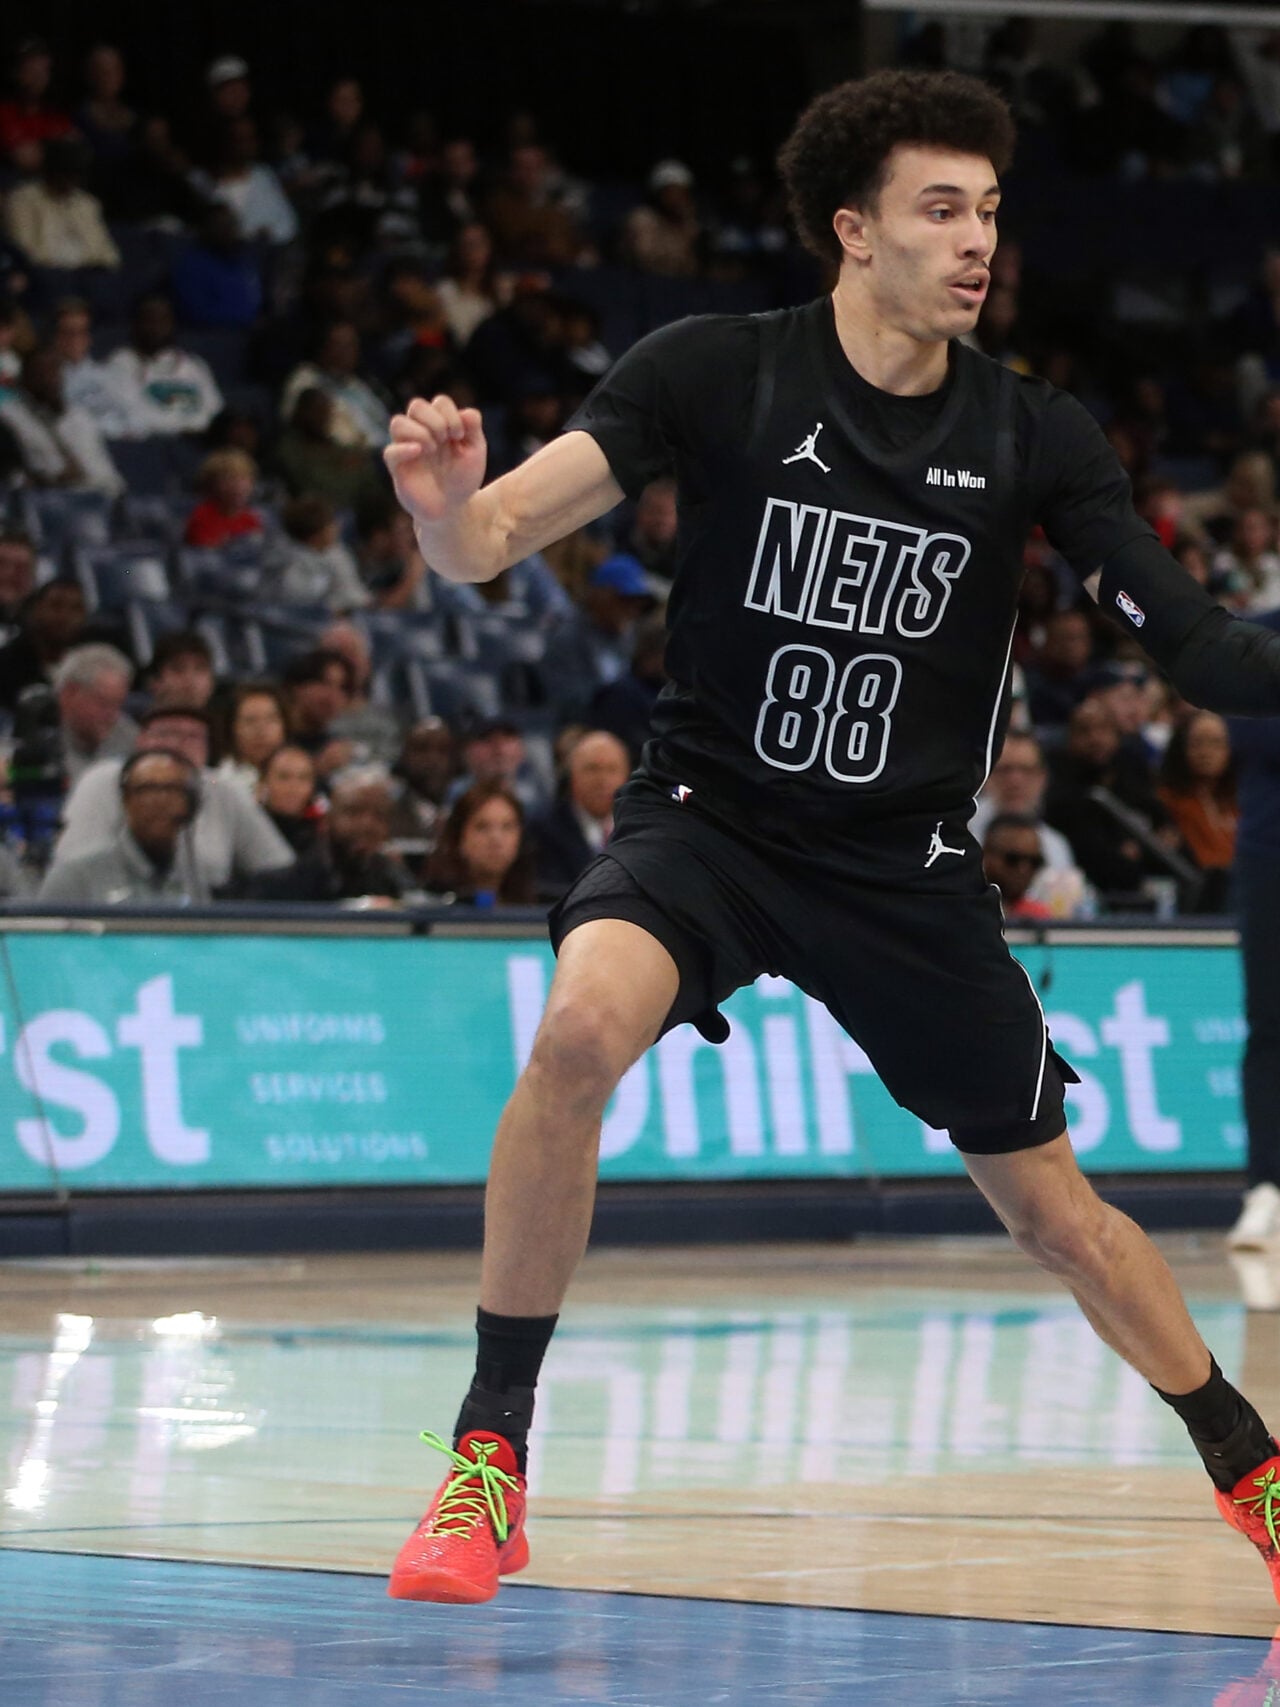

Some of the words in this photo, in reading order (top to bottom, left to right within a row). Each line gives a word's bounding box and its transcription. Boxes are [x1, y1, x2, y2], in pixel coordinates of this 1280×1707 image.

[926, 467, 941, 486] All
[943, 469, 956, 487] In
[957, 470, 986, 489] Won
[744, 497, 971, 638] NETS
[754, 644, 902, 783] 88
